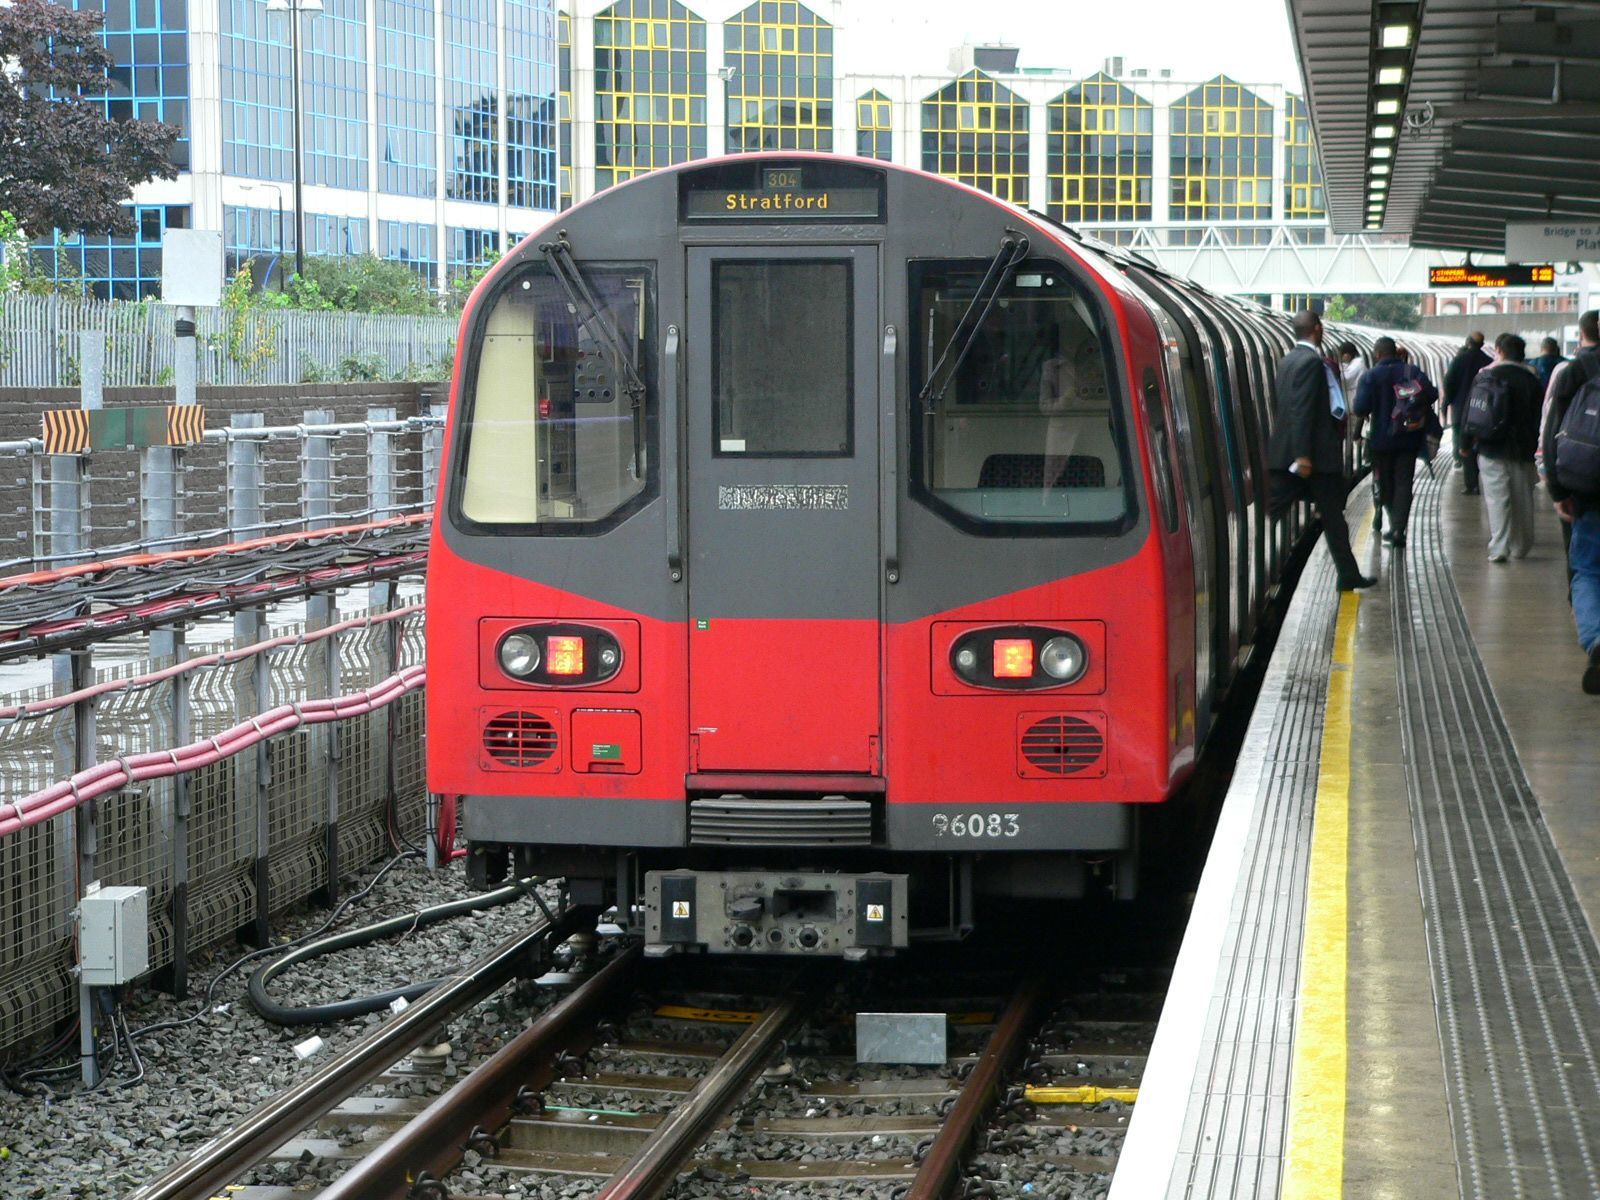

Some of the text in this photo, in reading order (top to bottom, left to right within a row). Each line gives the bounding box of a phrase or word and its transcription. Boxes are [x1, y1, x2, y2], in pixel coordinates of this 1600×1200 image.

[768, 172, 797, 188] 304
[726, 193, 829, 210] Stratford
[1544, 226, 1576, 238] Bridge
[932, 813, 1020, 837] 96083
